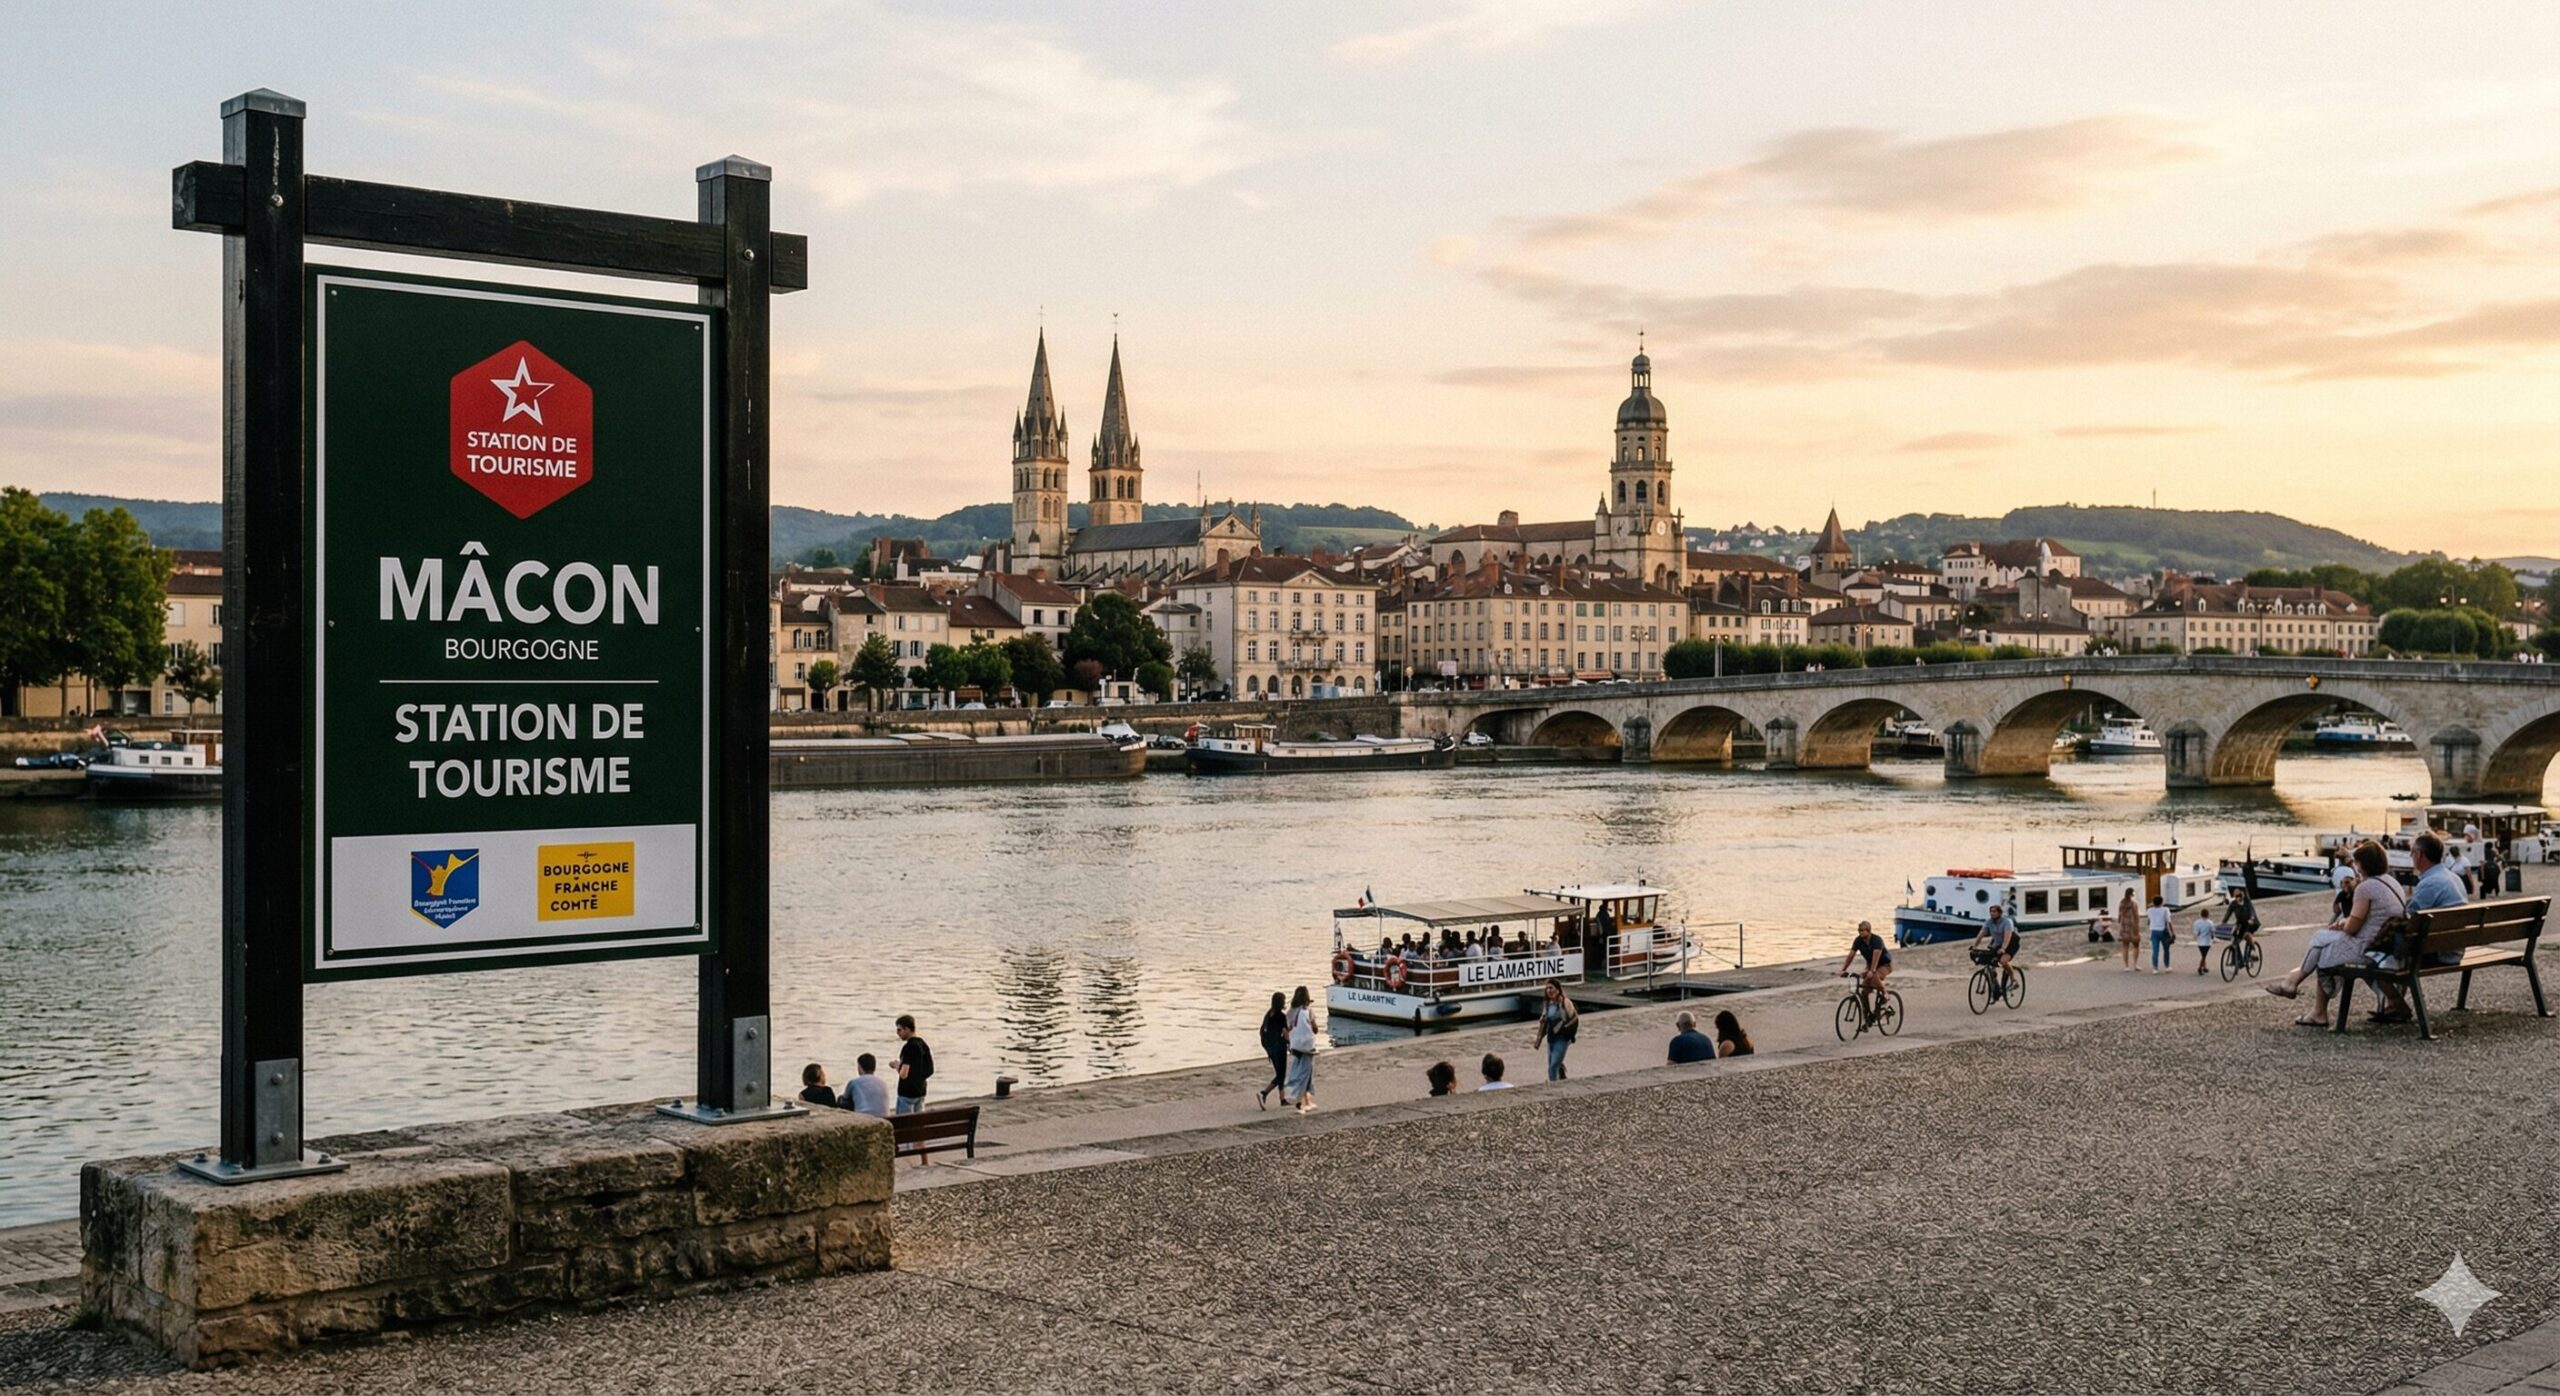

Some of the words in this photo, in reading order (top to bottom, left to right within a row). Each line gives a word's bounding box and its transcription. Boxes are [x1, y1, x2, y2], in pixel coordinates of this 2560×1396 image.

[467, 431, 547, 452] STATION
[552, 436, 577, 454] DE
[467, 454, 577, 478] TOURISME
[380, 541, 659, 625] MÂCON
[445, 638, 599, 660] BOURGOGNE
[394, 703, 576, 743] STATION
[592, 703, 644, 740] DE
[409, 757, 631, 799] TOURISME
[543, 862, 629, 877] BOURGOGNE
[554, 880, 618, 894] FRANCHE
[1467, 966, 1484, 983] LE
[1488, 958, 1565, 980] LAMARTINE
[1348, 991, 1356, 1001] LE
